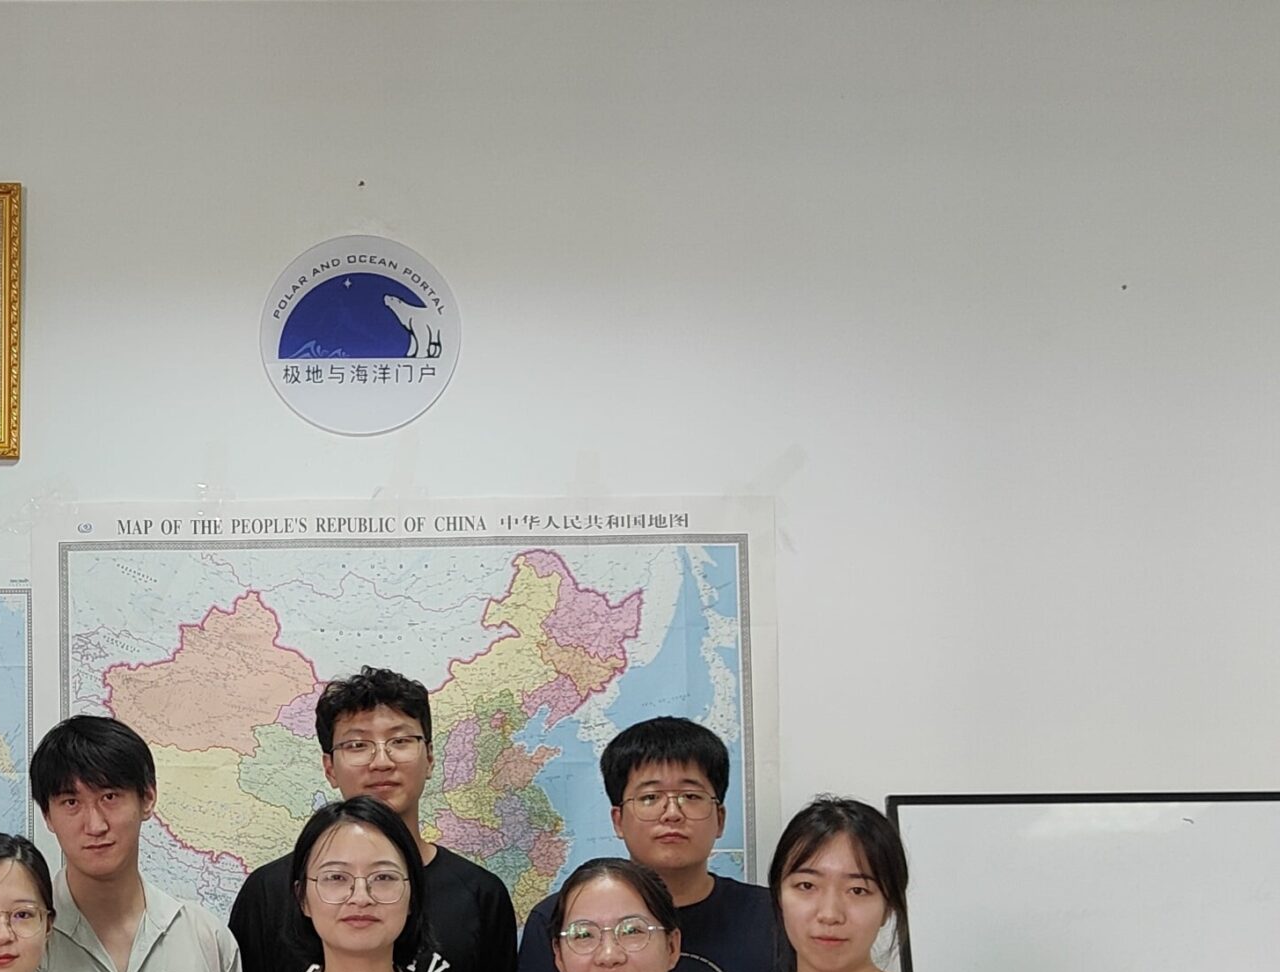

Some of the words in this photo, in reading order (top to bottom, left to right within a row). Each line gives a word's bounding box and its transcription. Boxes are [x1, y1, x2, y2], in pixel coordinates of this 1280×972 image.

[273, 276, 308, 319] POLAR
[312, 258, 341, 277] AND
[347, 254, 398, 270] OCEAN
[402, 267, 449, 315] PORTAL
[282, 364, 436, 384] 极地与海洋门户
[117, 519, 153, 535] MAP
[160, 519, 183, 535] OF
[190, 519, 223, 535] THE
[231, 517, 308, 534] PEOPLE'S
[315, 517, 396, 533] REPUBLIC
[404, 516, 426, 533] OF
[434, 515, 487, 532] CHINA
[500, 513, 689, 531] 中华人民共和国地图
